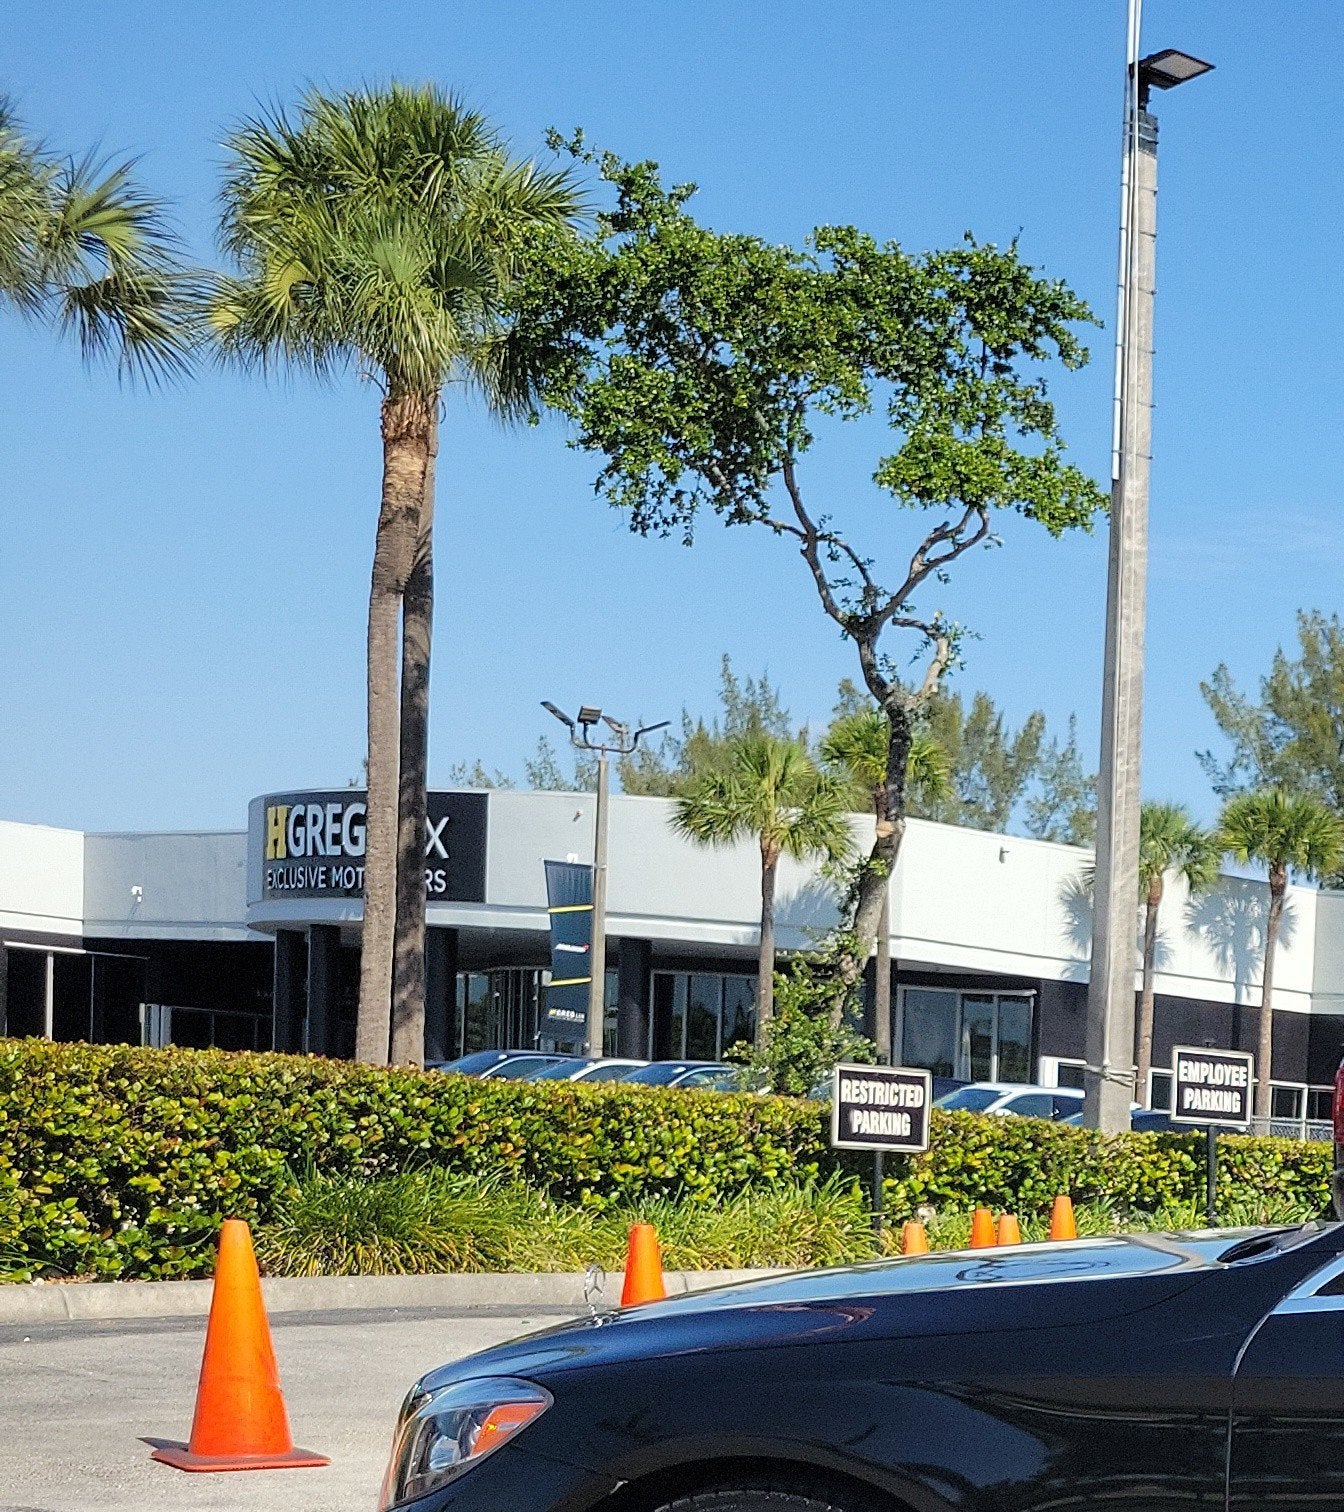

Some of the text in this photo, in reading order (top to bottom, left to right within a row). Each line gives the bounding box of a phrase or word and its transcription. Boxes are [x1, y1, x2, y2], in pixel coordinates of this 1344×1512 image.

[267, 866, 327, 890] EXCLUSIVE
[1179, 1060, 1248, 1087] EMPLOYEE
[840, 1078, 924, 1108] RESTRICTED
[1183, 1087, 1241, 1113] PARKING
[851, 1109, 911, 1137] PARKING
